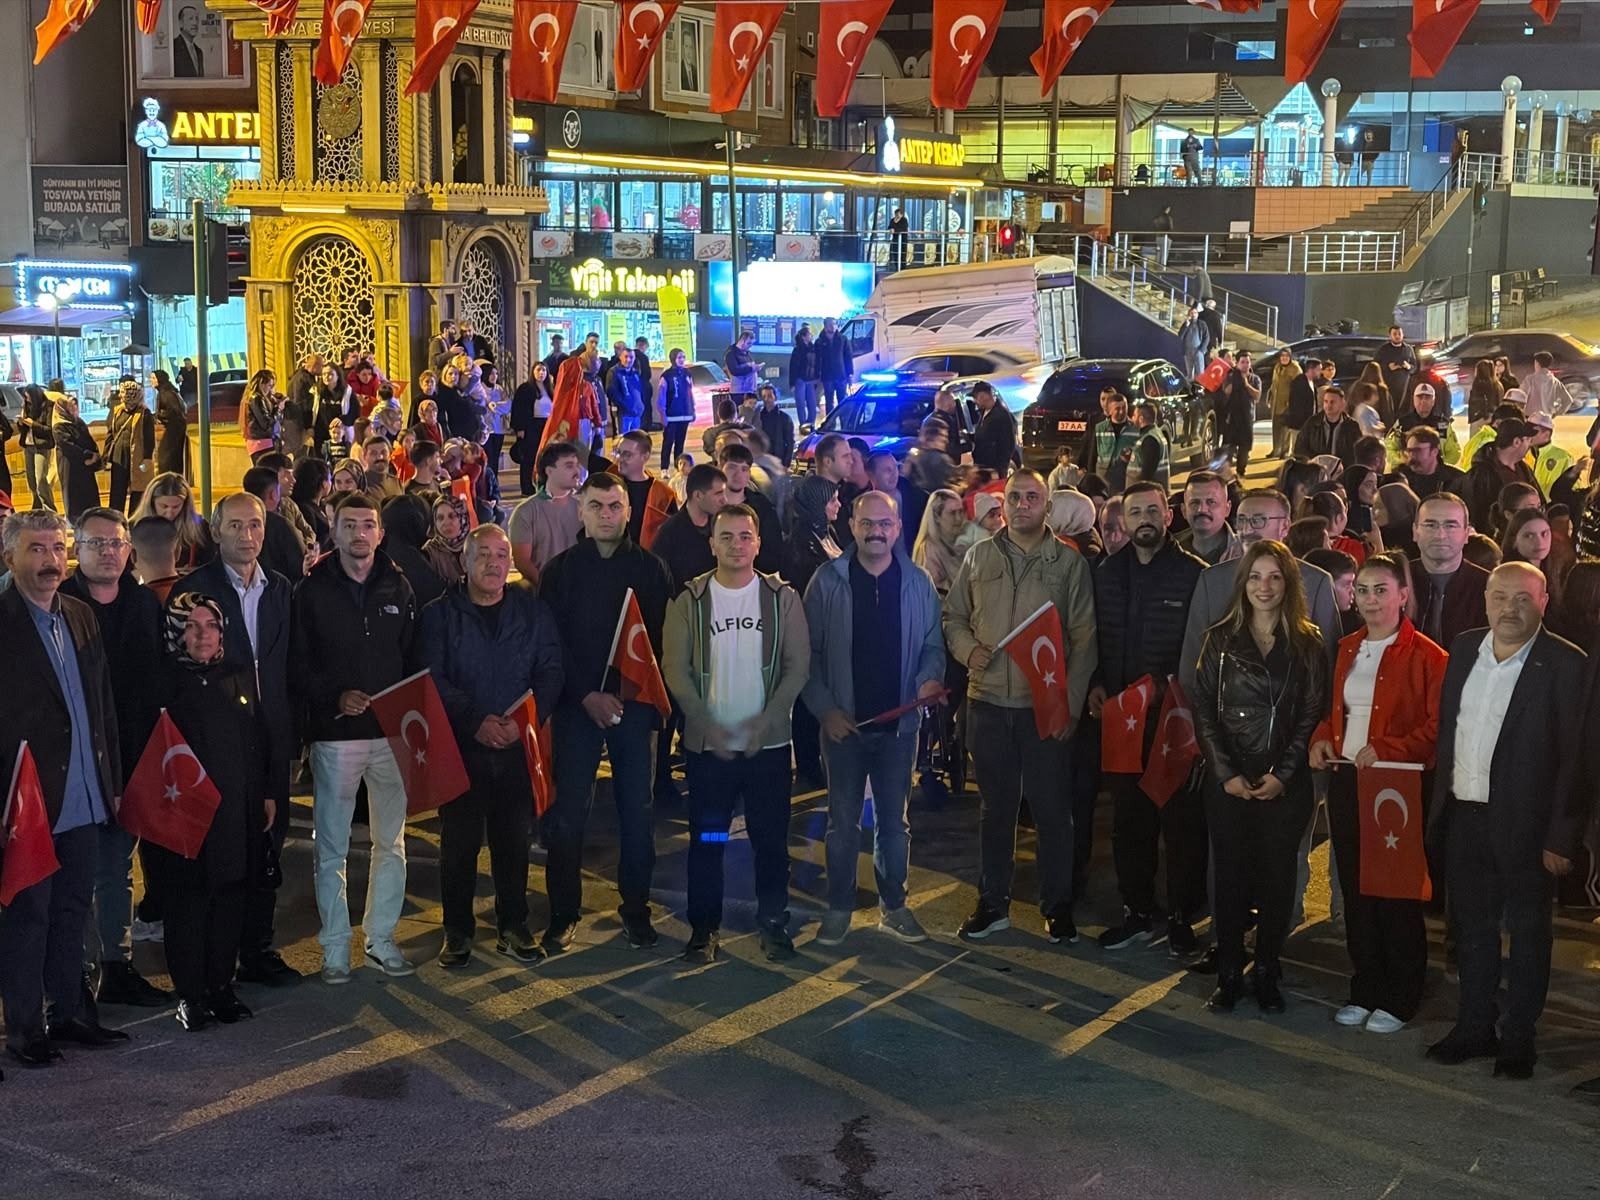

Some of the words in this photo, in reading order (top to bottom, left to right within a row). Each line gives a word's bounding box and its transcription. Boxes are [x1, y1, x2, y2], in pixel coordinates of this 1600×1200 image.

[262, 22, 308, 36] TSYA
[473, 28, 513, 47] BELEDİY
[900, 138, 933, 165] ANTEP
[933, 141, 965, 167] KEBAP
[77, 179, 86, 188] EN
[43, 190, 86, 200] TOSYA'DA
[87, 189, 121, 202] YETİŞİR
[44, 202, 84, 213] BURADA
[85, 202, 121, 214] SATILIR
[615, 267, 695, 297] Teknooji
[710, 617, 763, 636] ILFIGE
